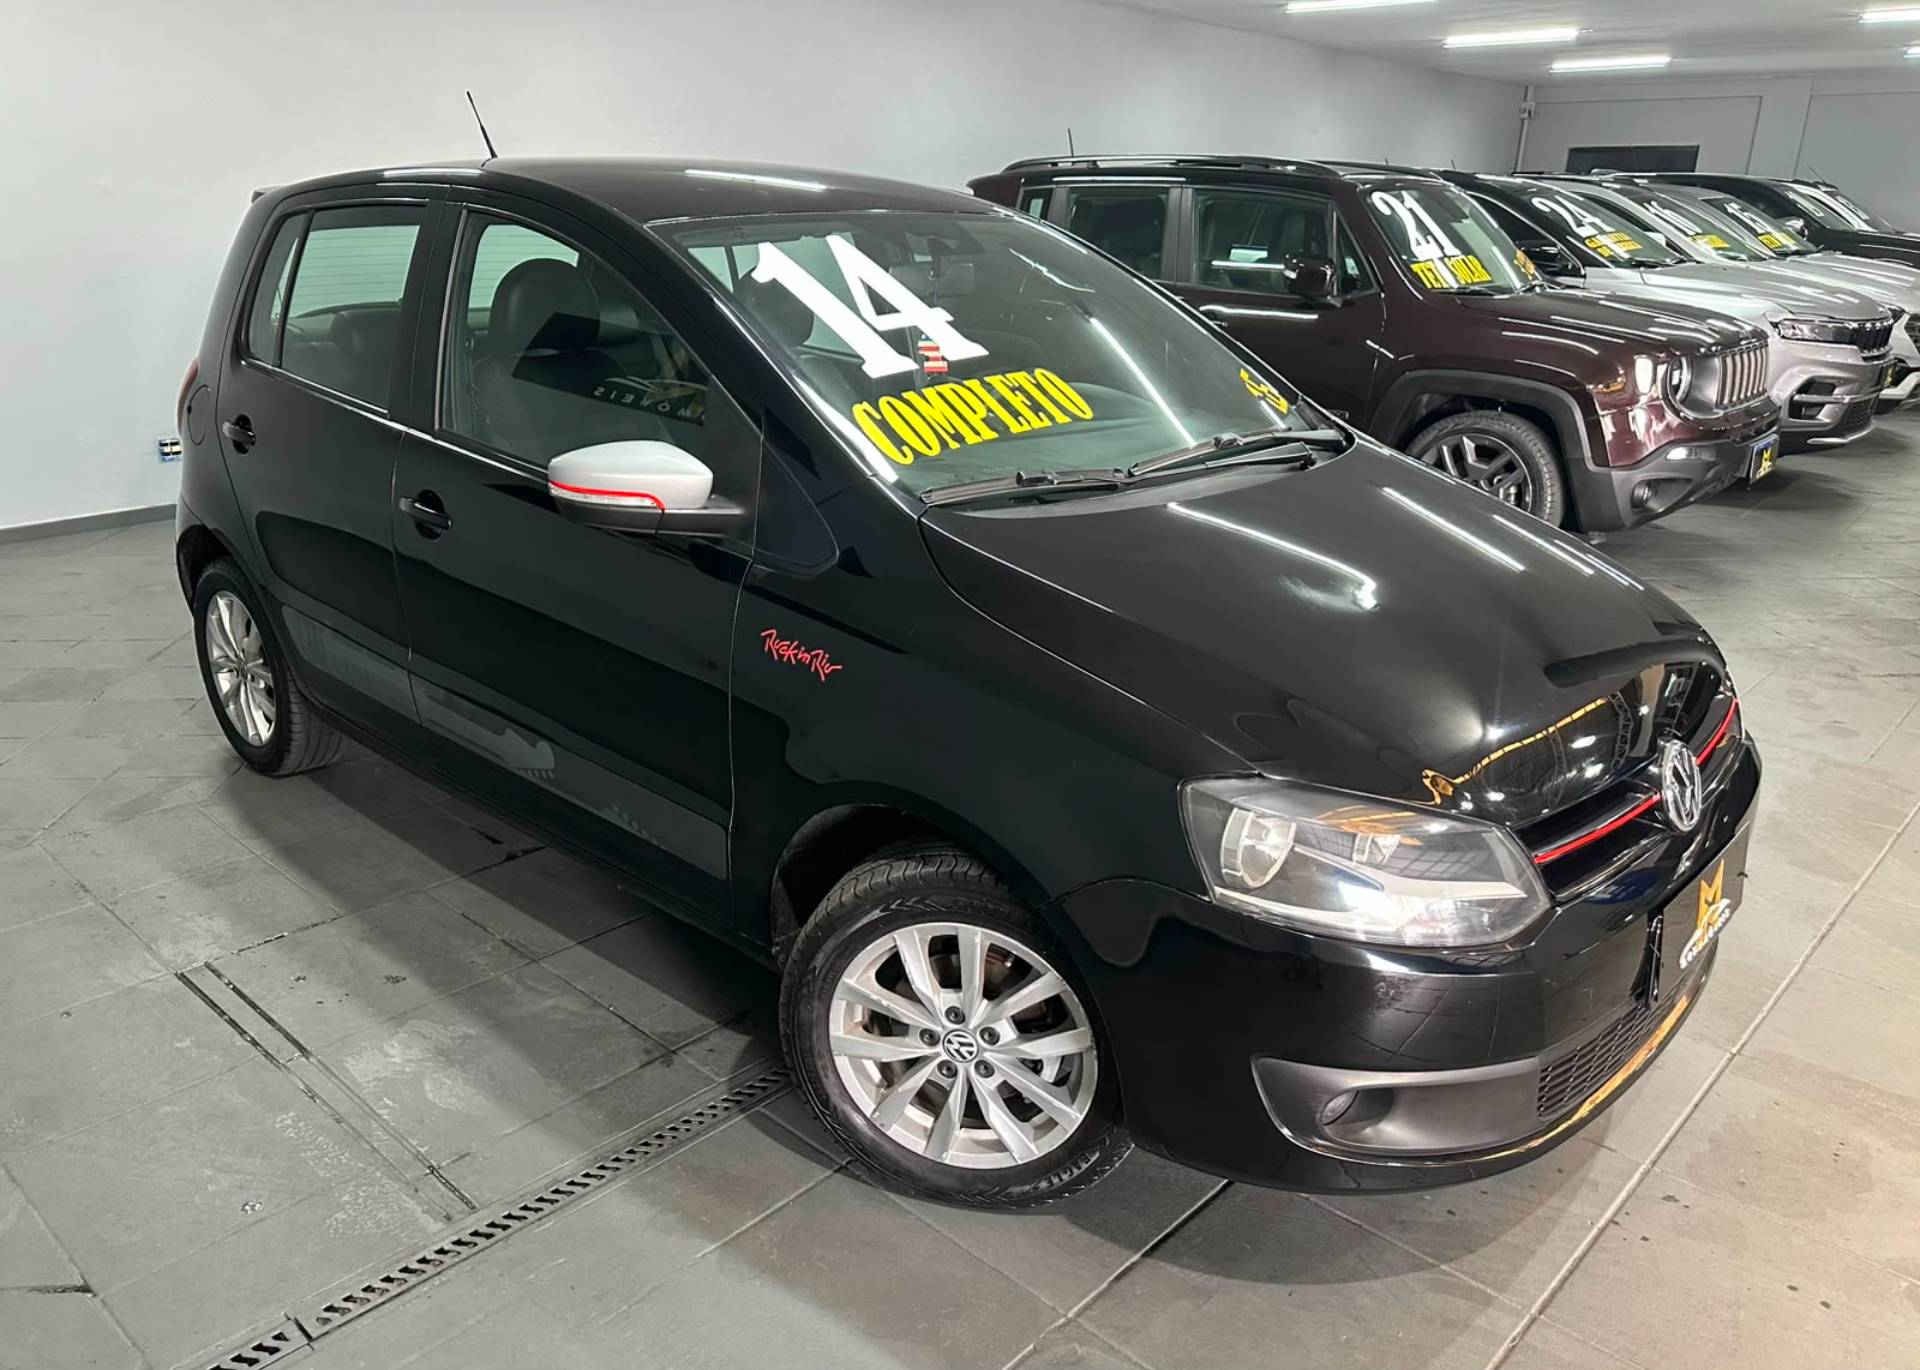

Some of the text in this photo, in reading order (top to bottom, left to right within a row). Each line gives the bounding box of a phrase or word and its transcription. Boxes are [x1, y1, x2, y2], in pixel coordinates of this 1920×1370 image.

[1371, 191, 1461, 261] 21
[1531, 196, 1616, 238] 24
[751, 232, 989, 378] 14
[1409, 259, 1458, 289] TET
[852, 367, 1093, 465] COMPLETO
[760, 628, 799, 665] Rock
[810, 649, 842, 682] Rio
